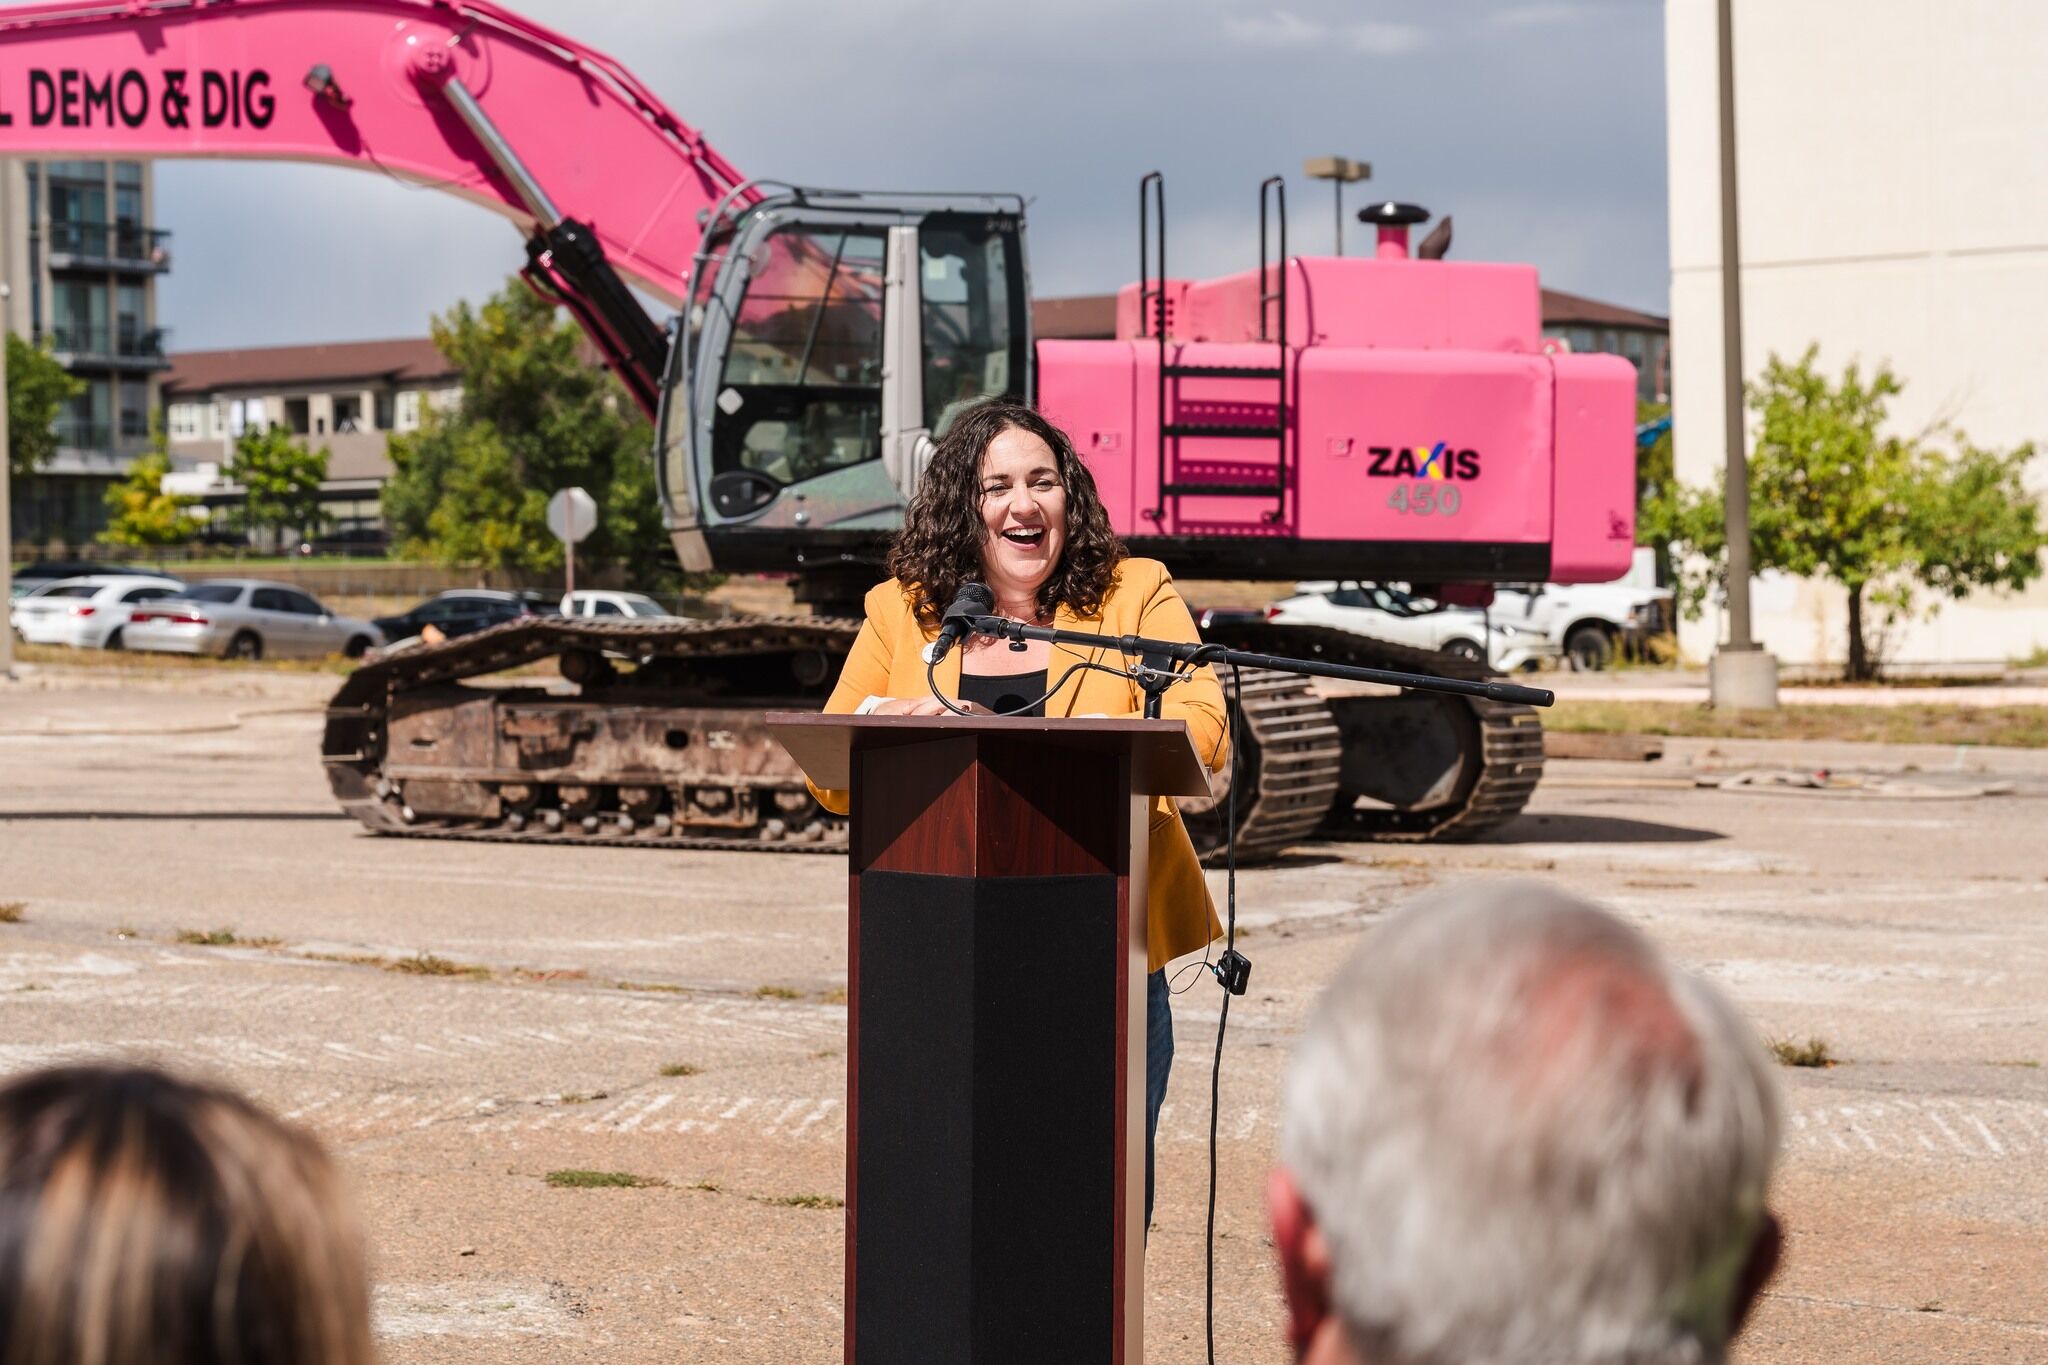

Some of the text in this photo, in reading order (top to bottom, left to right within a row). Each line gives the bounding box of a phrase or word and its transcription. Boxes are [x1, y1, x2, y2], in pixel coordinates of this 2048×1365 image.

[29, 69, 276, 129] DEMO & DIG
[1367, 441, 1480, 480] ZAXIS
[1387, 484, 1461, 516] 450
